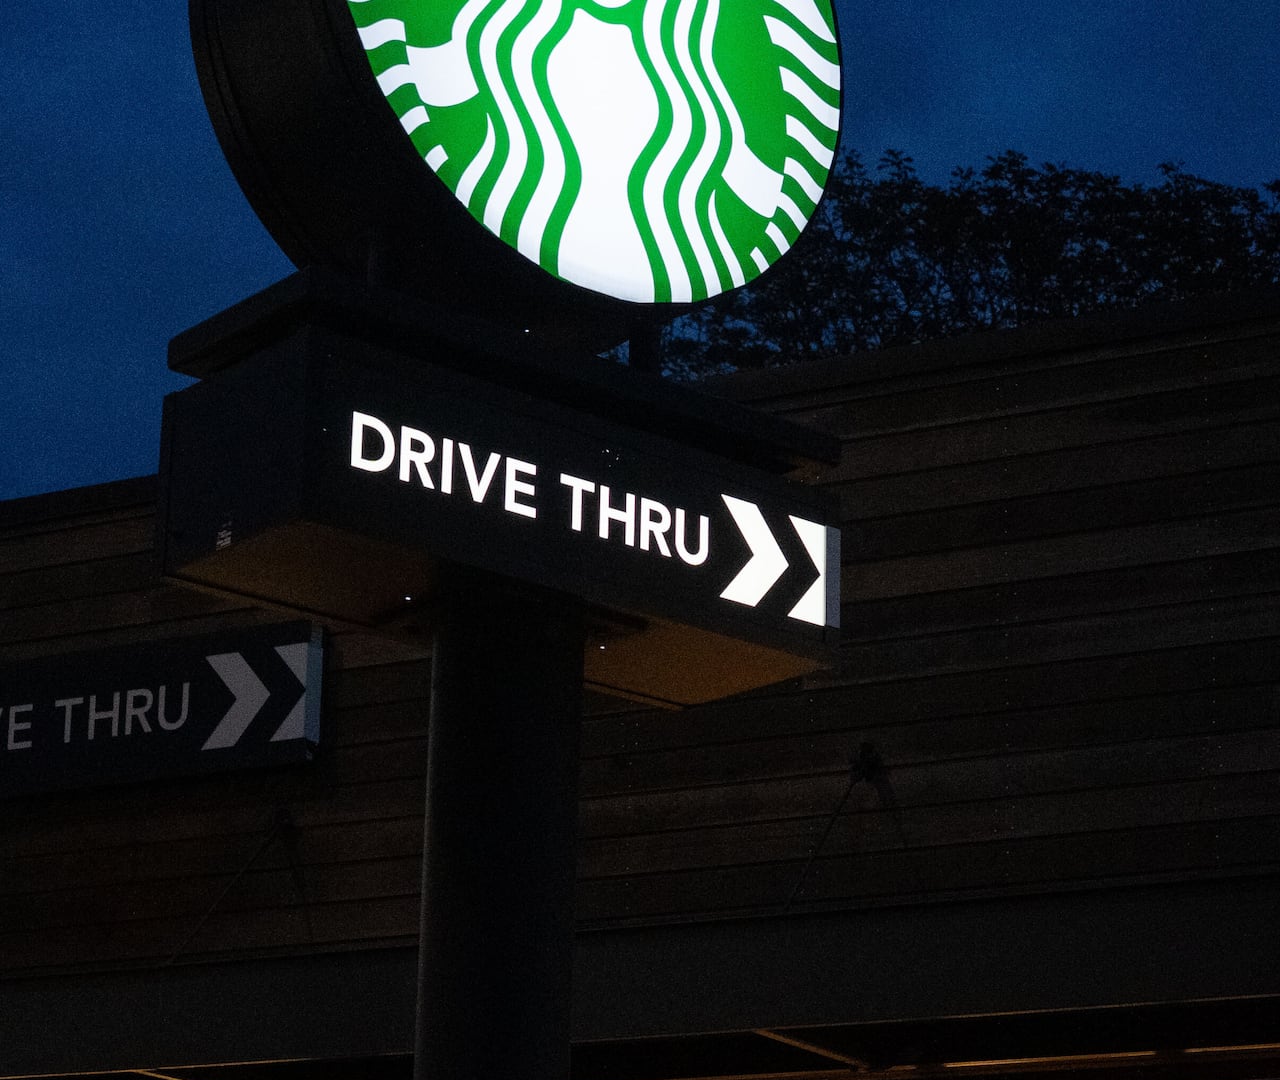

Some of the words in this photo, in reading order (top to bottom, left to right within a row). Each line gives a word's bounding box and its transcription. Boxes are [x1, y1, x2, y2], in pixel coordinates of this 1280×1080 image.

[350, 410, 538, 520] DRIVE
[559, 472, 711, 567] THRU
[55, 681, 191, 744] THRU
